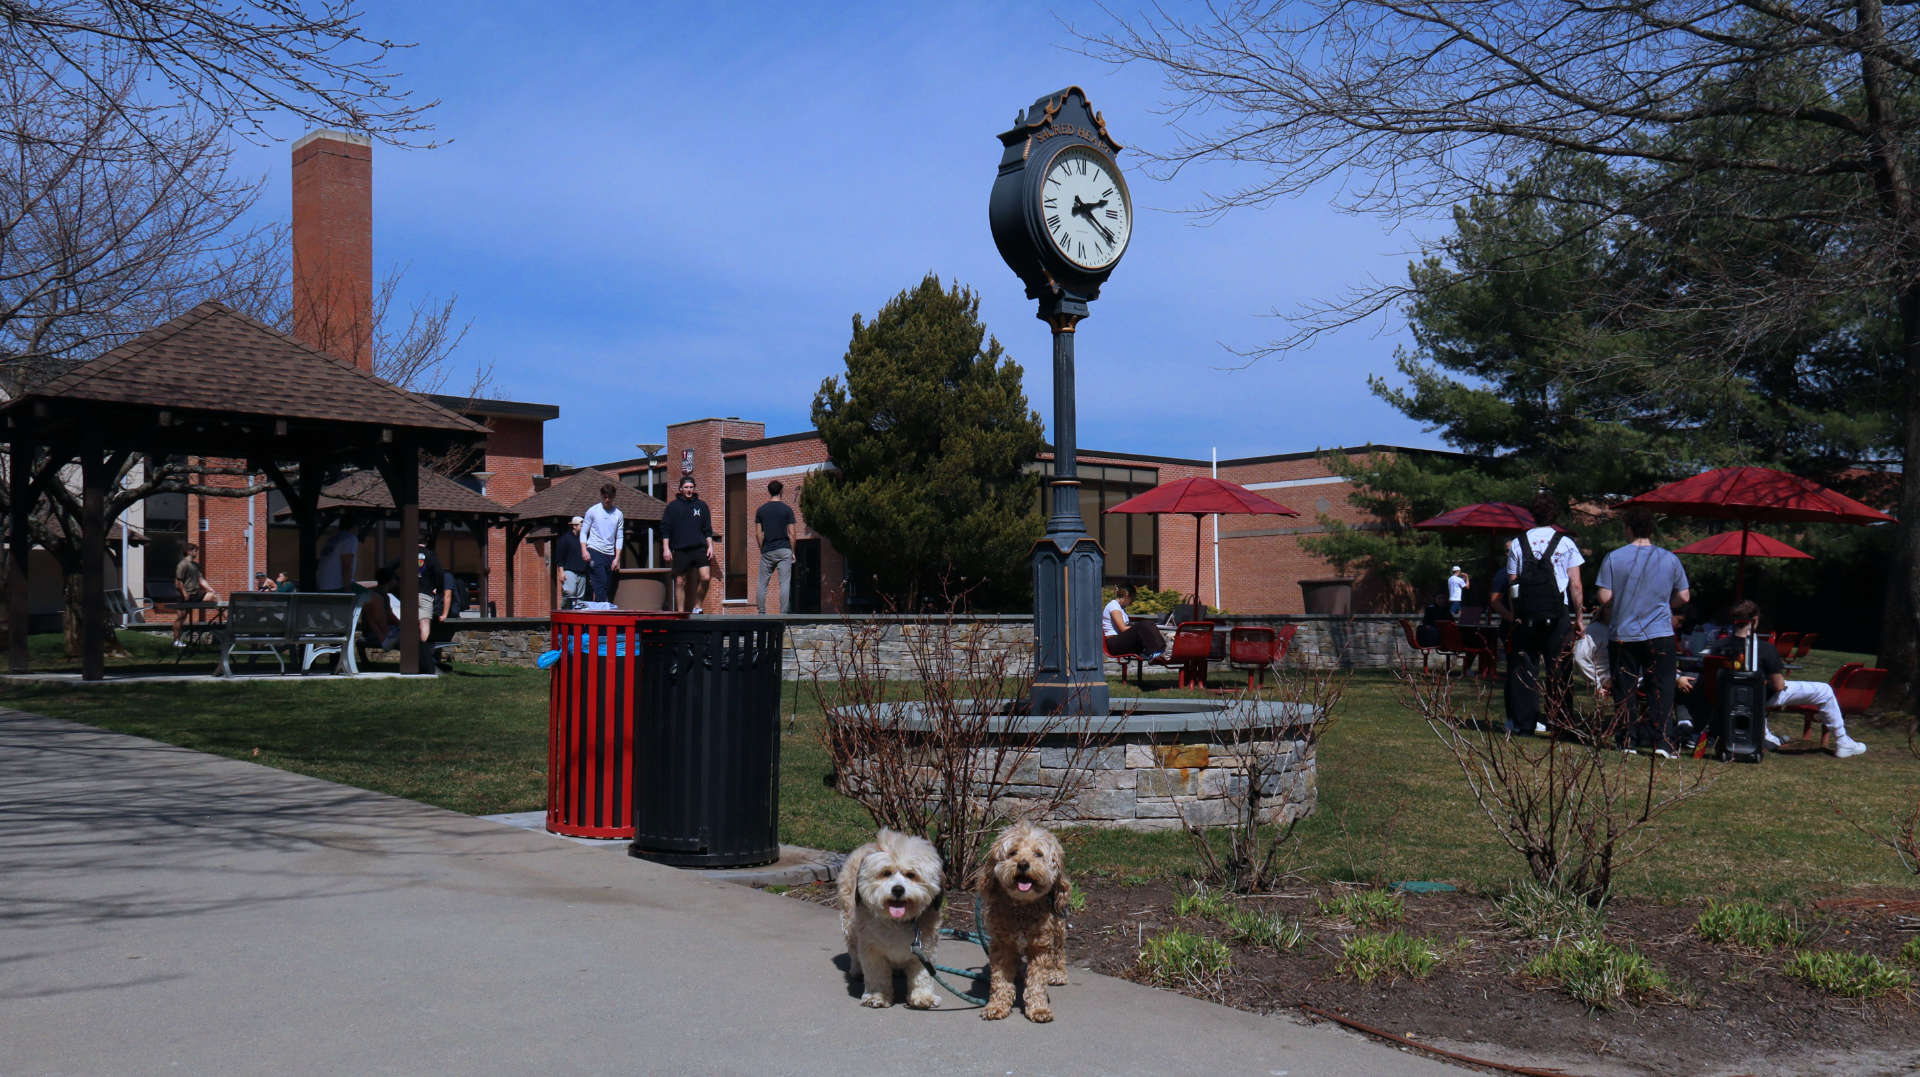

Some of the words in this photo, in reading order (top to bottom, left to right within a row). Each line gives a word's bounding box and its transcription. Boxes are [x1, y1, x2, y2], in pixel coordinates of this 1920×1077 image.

[1036, 123, 1074, 143] SACRED
[1077, 124, 1111, 153] HEART
[1058, 159, 1073, 179] XI
[1072, 155, 1087, 176] XII
[1047, 175, 1062, 191] X
[1092, 168, 1100, 184] I
[1044, 194, 1058, 209] IX
[1102, 187, 1114, 199] II
[1105, 209, 1119, 220] III
[1047, 214, 1061, 235] VIII
[1059, 231, 1072, 253] VII
[1078, 240, 1087, 259] VI
